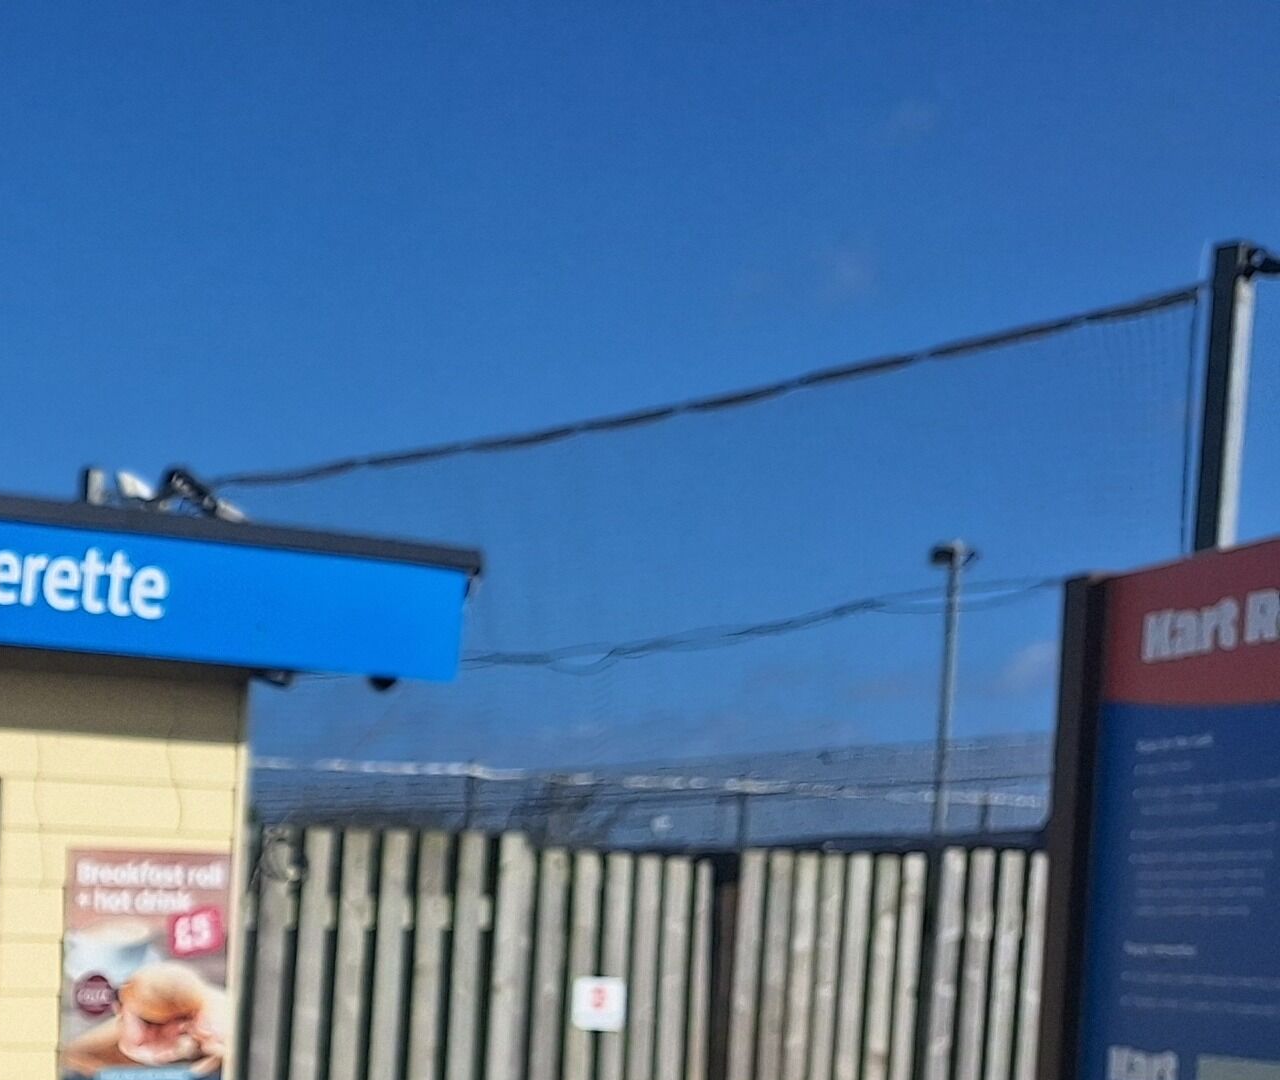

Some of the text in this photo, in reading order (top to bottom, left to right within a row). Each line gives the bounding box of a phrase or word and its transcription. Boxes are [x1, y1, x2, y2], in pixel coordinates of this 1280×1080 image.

[1142, 597, 1238, 663] Kart
[76, 860, 225, 888] Breakfast roll
[94, 888, 130, 912] hot
[134, 889, 191, 914] drink
